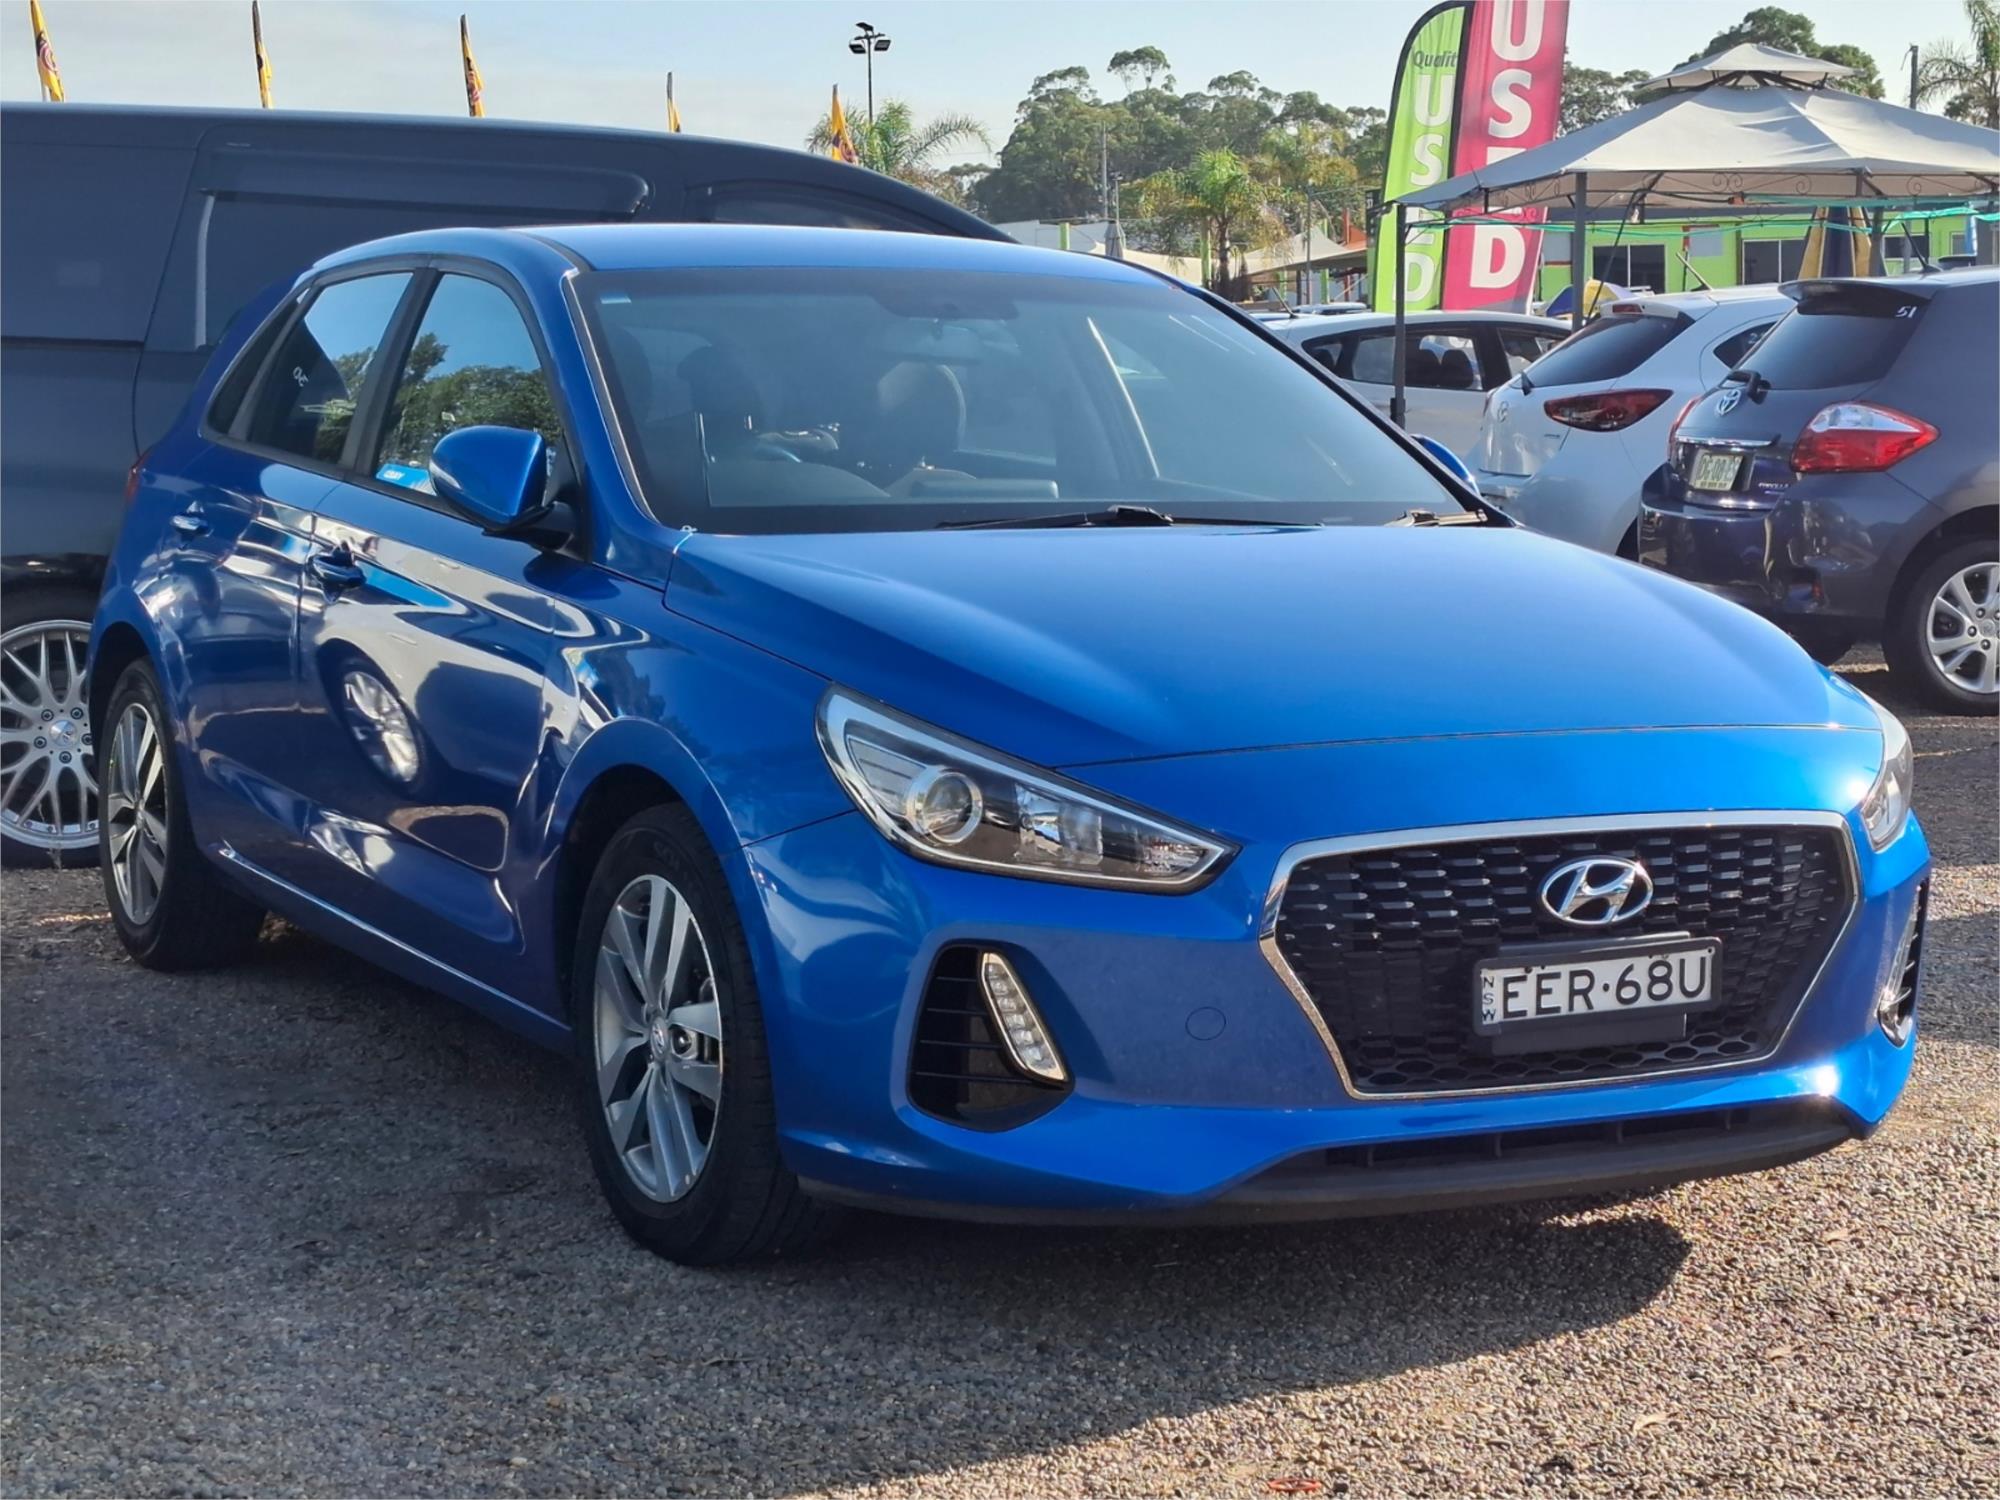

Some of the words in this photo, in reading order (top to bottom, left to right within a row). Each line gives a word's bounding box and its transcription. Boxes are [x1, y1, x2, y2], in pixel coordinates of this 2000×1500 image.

[1413, 51, 1458, 69] Qualit
[1470, 0, 1544, 288] USD
[1895, 305, 1917, 318] 51
